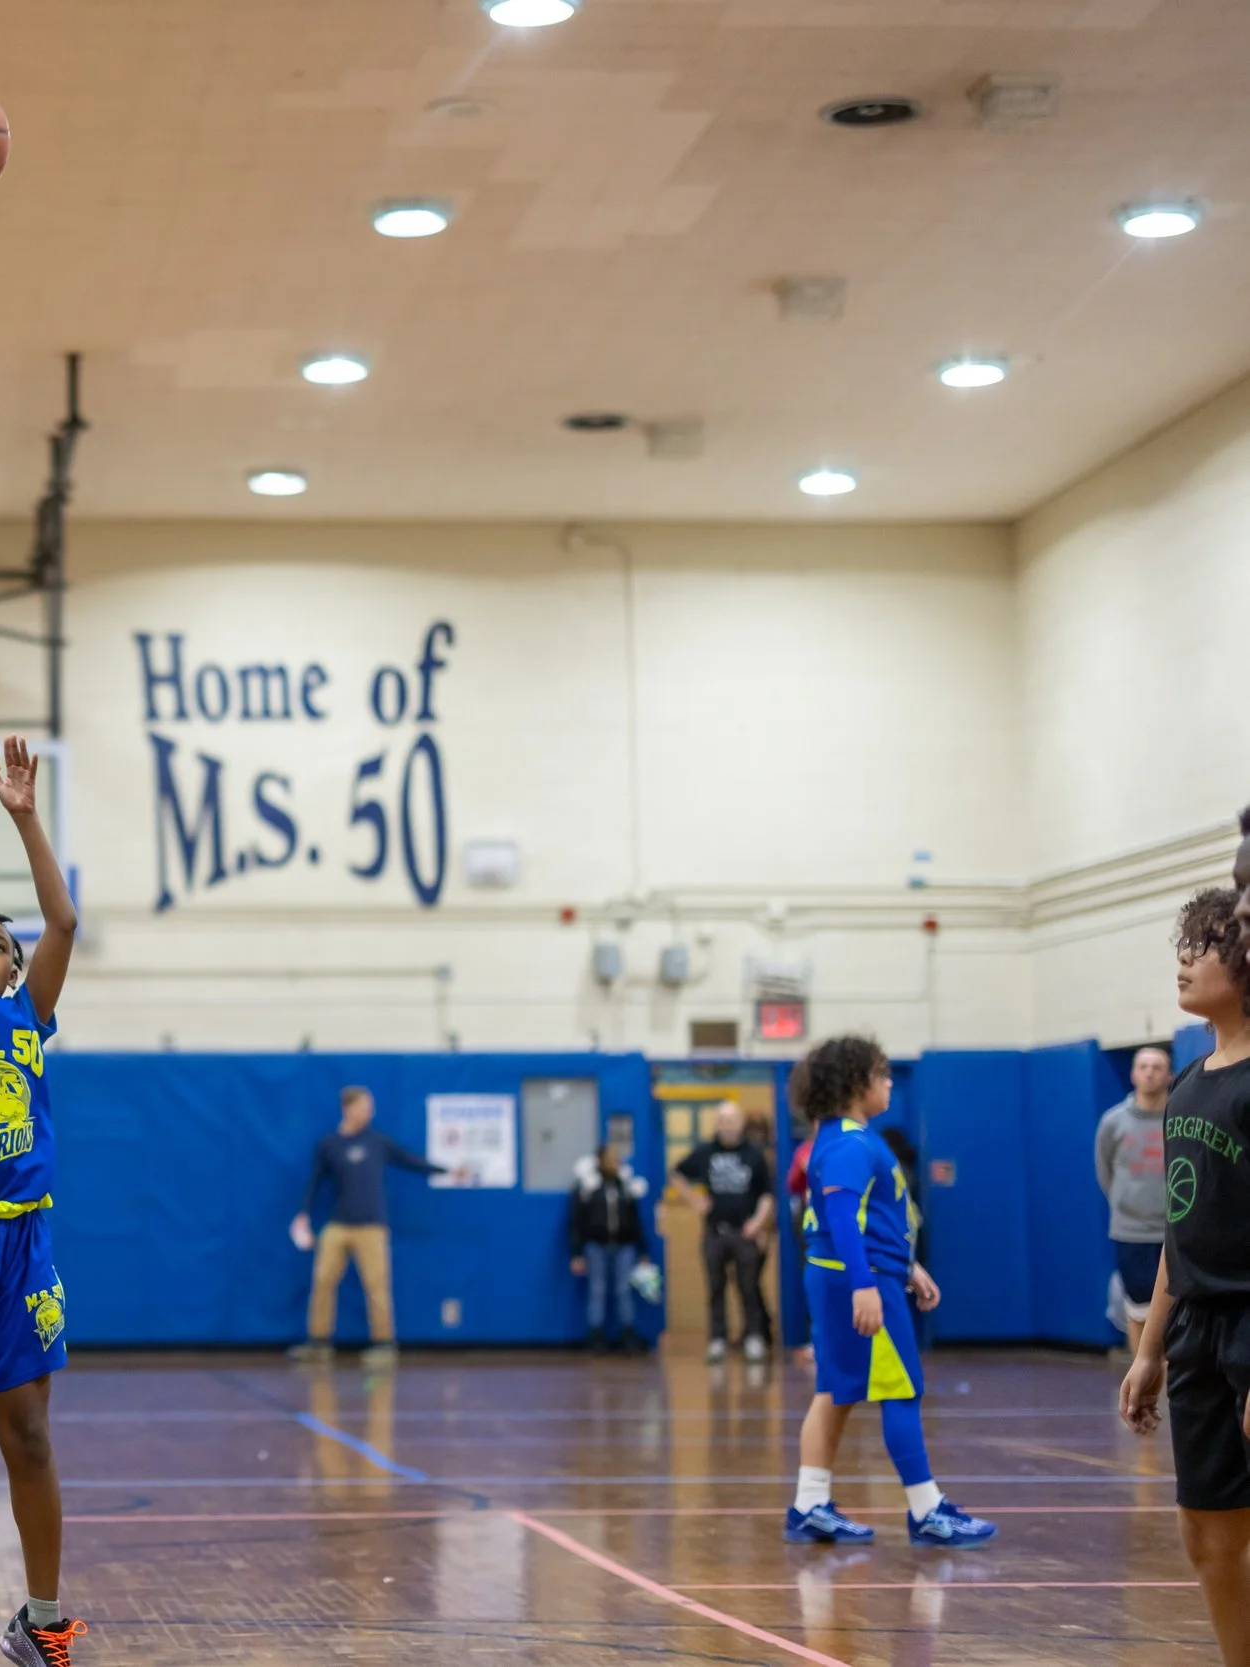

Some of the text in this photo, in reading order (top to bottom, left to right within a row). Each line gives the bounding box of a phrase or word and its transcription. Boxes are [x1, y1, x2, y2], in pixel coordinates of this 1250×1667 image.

[132, 616, 456, 728] Home of
[146, 729, 447, 915] M.S. 50
[12, 1028, 44, 1078] 50
